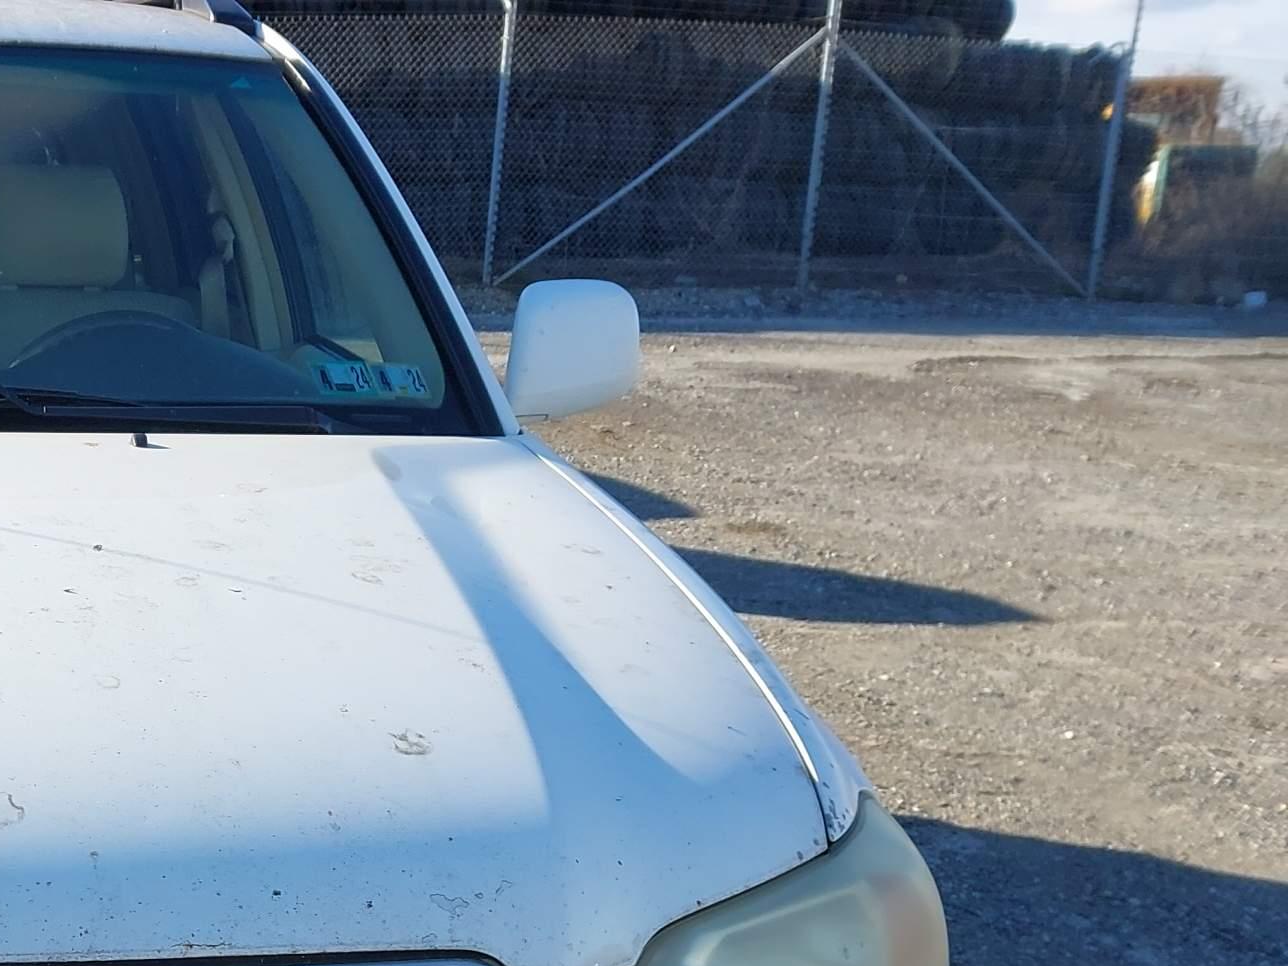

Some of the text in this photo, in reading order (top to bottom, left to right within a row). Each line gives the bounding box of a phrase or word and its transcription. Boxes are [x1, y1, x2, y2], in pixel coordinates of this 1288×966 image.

[319, 365, 371, 391] 4 24
[379, 368, 428, 393] 4 24
